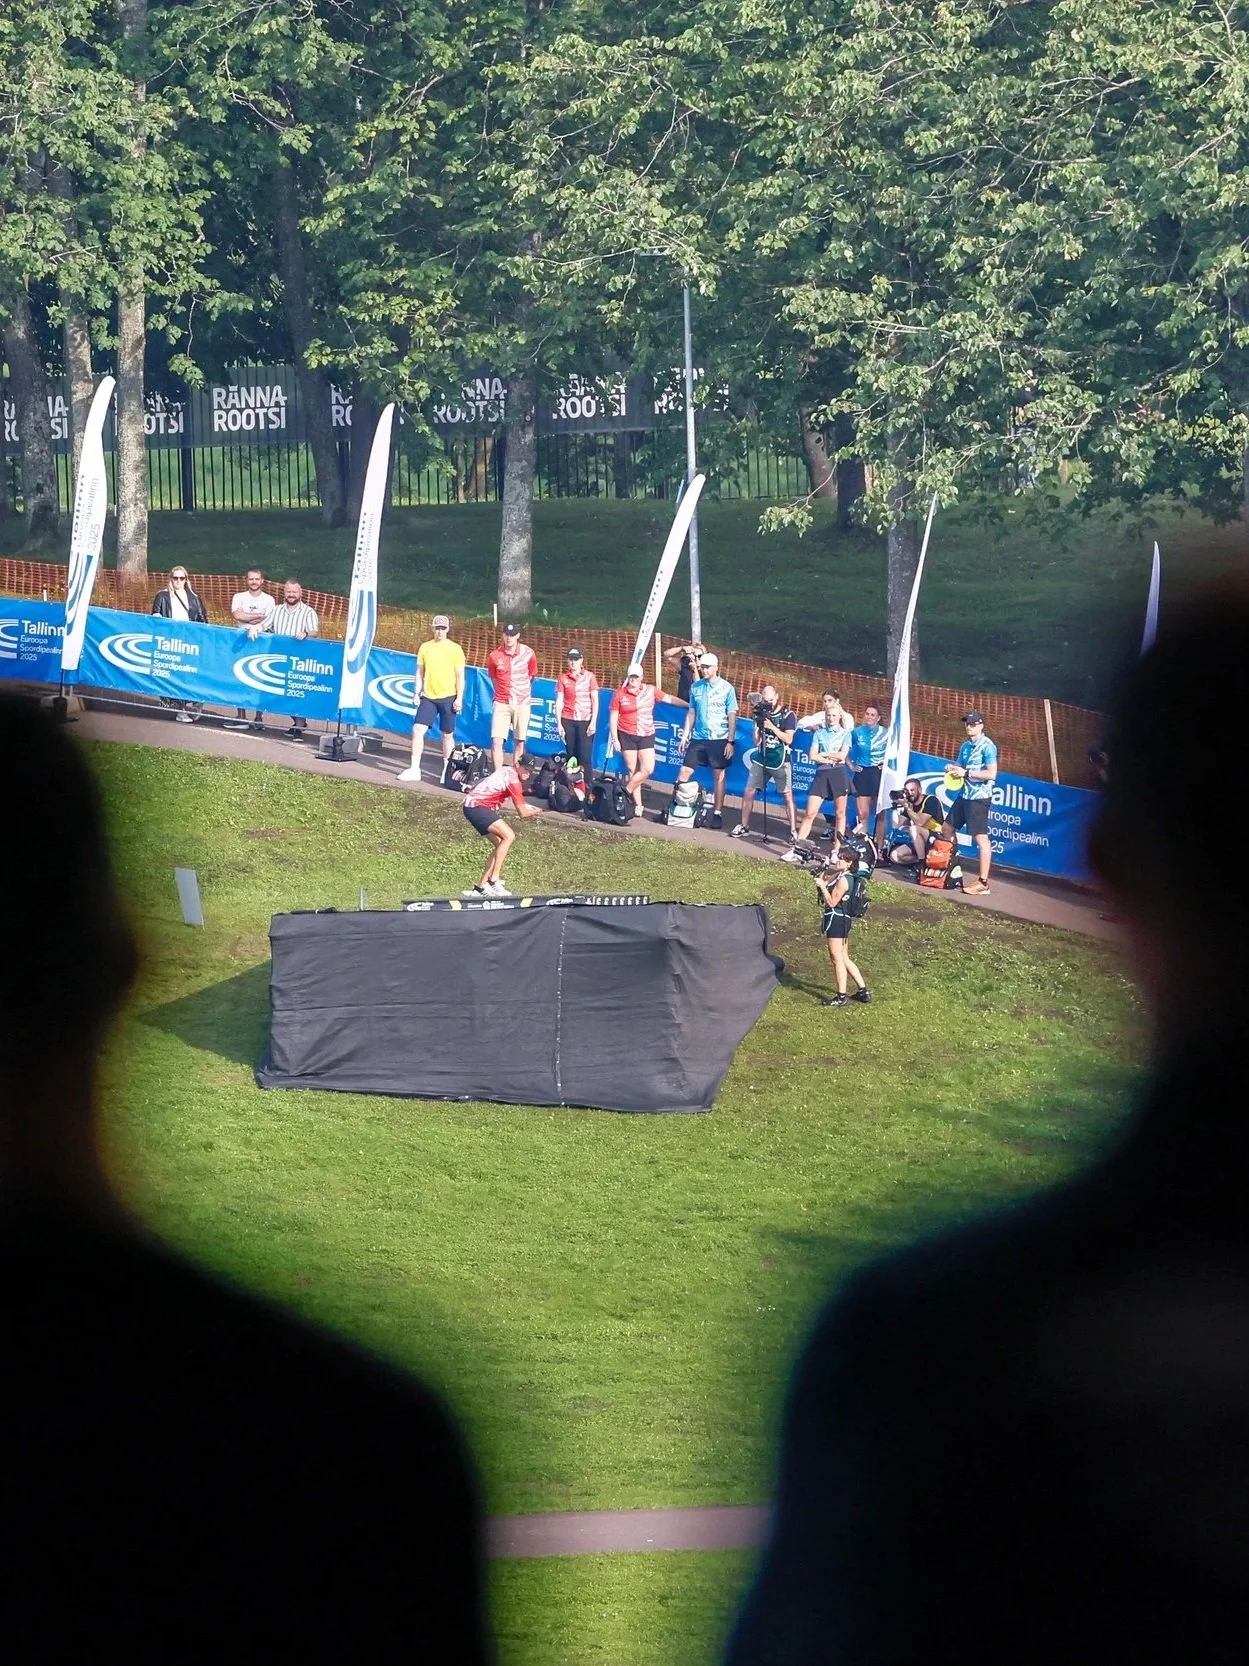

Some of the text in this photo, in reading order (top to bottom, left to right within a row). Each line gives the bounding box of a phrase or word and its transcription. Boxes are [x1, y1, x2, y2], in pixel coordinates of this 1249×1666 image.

[213, 407, 286, 432] ROOTSI
[20, 634, 49, 644] Euroopa
[154, 635, 200, 656] Tallinn
[20, 652, 38, 661] 2025
[153, 650, 181, 662] Euroopa
[152, 659, 198, 674] Spordipealinn
[289, 656, 334, 676] Tallinn
[152, 668, 171, 679] 2025
[287, 670, 316, 682] Euroopa
[287, 679, 333, 694] Spordipealinn
[286, 688, 305, 699] 2025
[791, 781, 809, 791] 2025
[989, 783, 1052, 816] allinn
